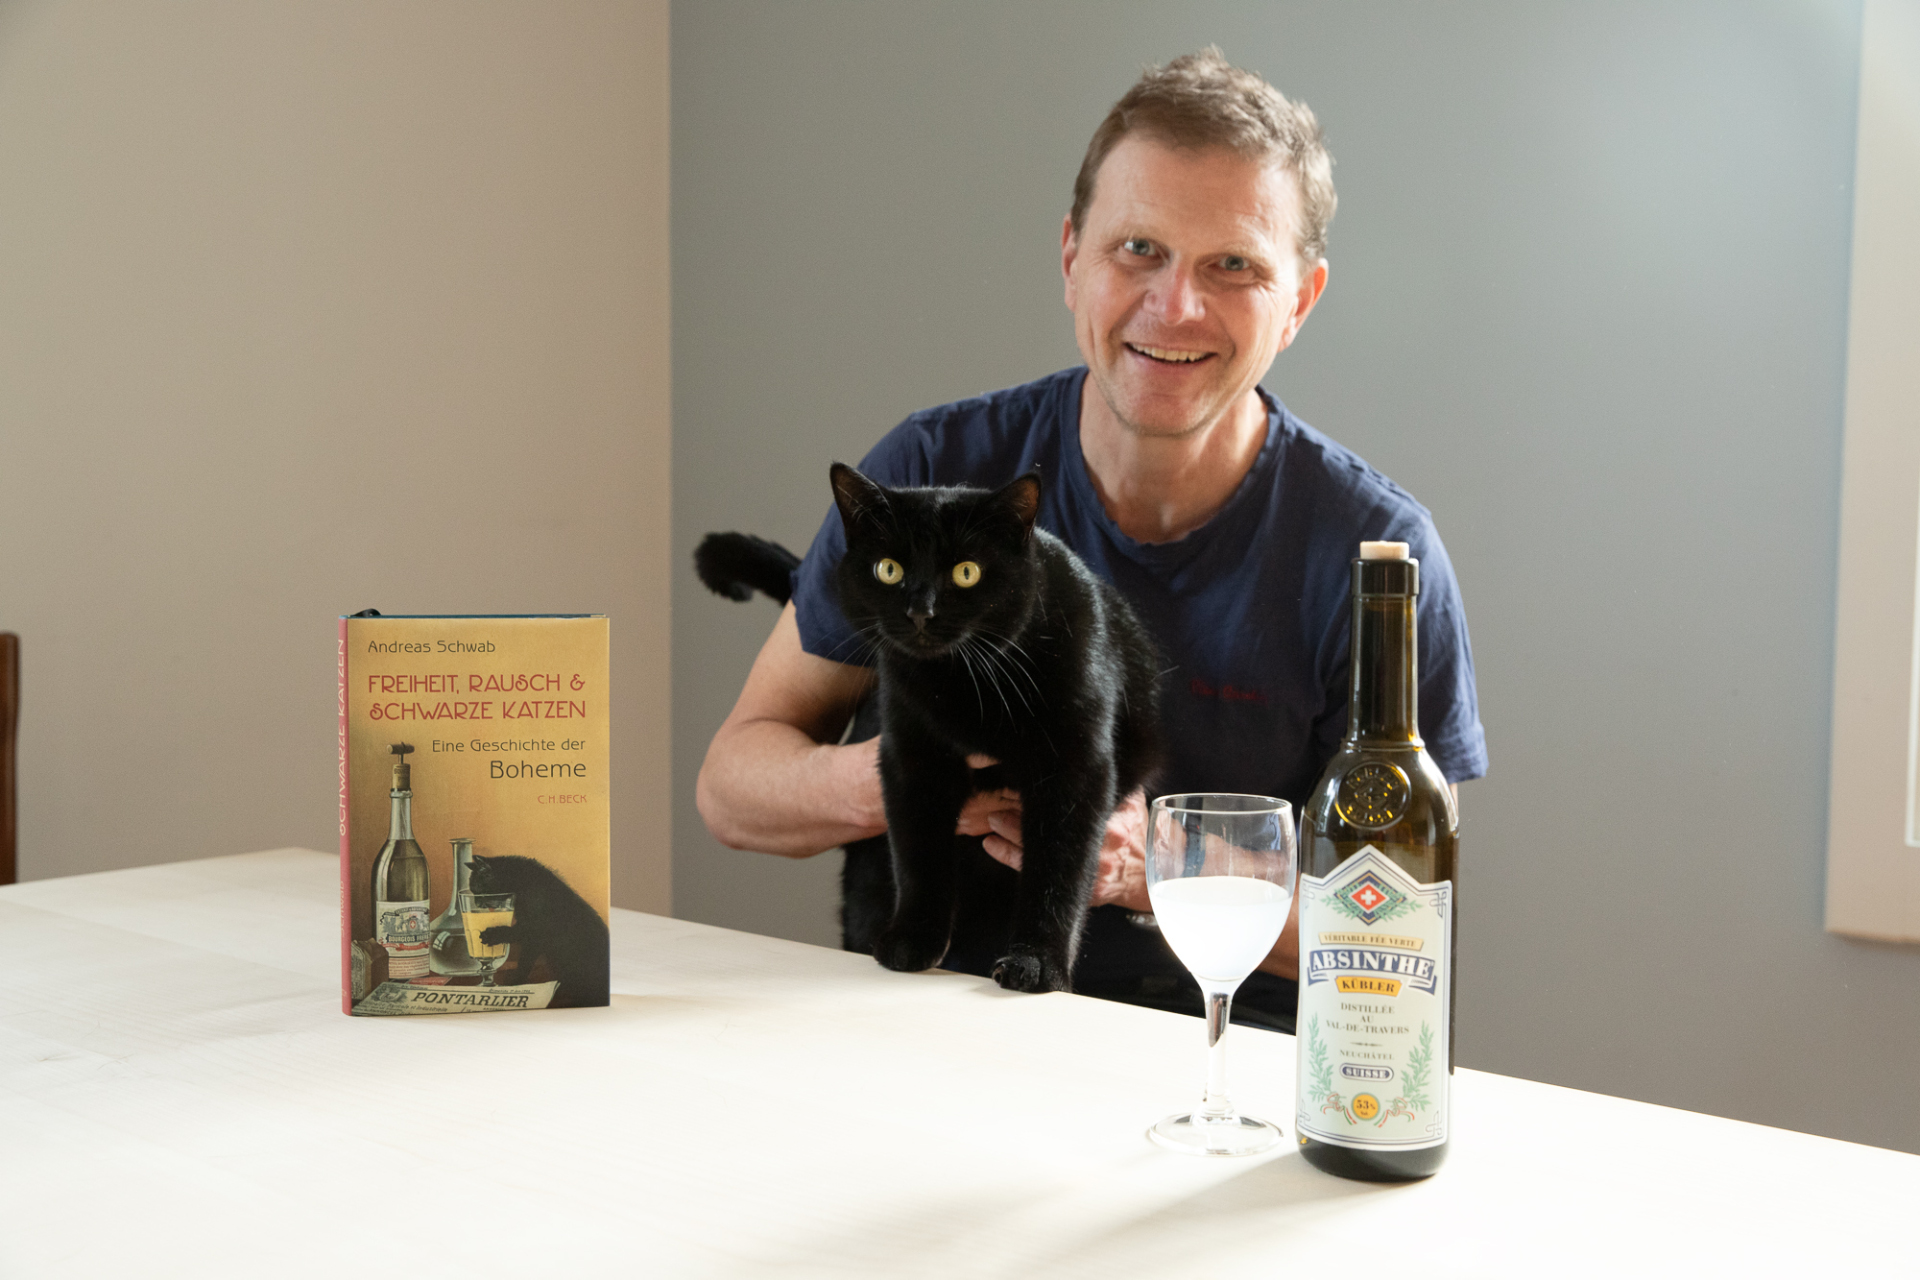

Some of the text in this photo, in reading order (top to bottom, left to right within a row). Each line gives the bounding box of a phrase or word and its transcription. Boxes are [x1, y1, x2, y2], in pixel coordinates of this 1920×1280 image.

[367, 639, 496, 653] Andreas Schwab
[368, 673, 586, 694] FREIHEIT, RAUSCH &
[369, 700, 586, 720] SCHWARZE KATZEN
[432, 738, 586, 753] Eine Geschichte der
[490, 760, 587, 779] Boheme
[1312, 950, 1431, 978] ABSINTHE
[1342, 978, 1395, 993] KÜBLER
[410, 991, 530, 1008] PONTARLIER
[1341, 1002, 1395, 1015] DISTILLÉE
[1326, 1019, 1410, 1035] VAL-DE-TRAVERS
[1360, 1015, 1374, 1024] AU
[1339, 1049, 1395, 1061] NEUCHÂTEL
[1345, 1067, 1387, 1079] SUISSE
